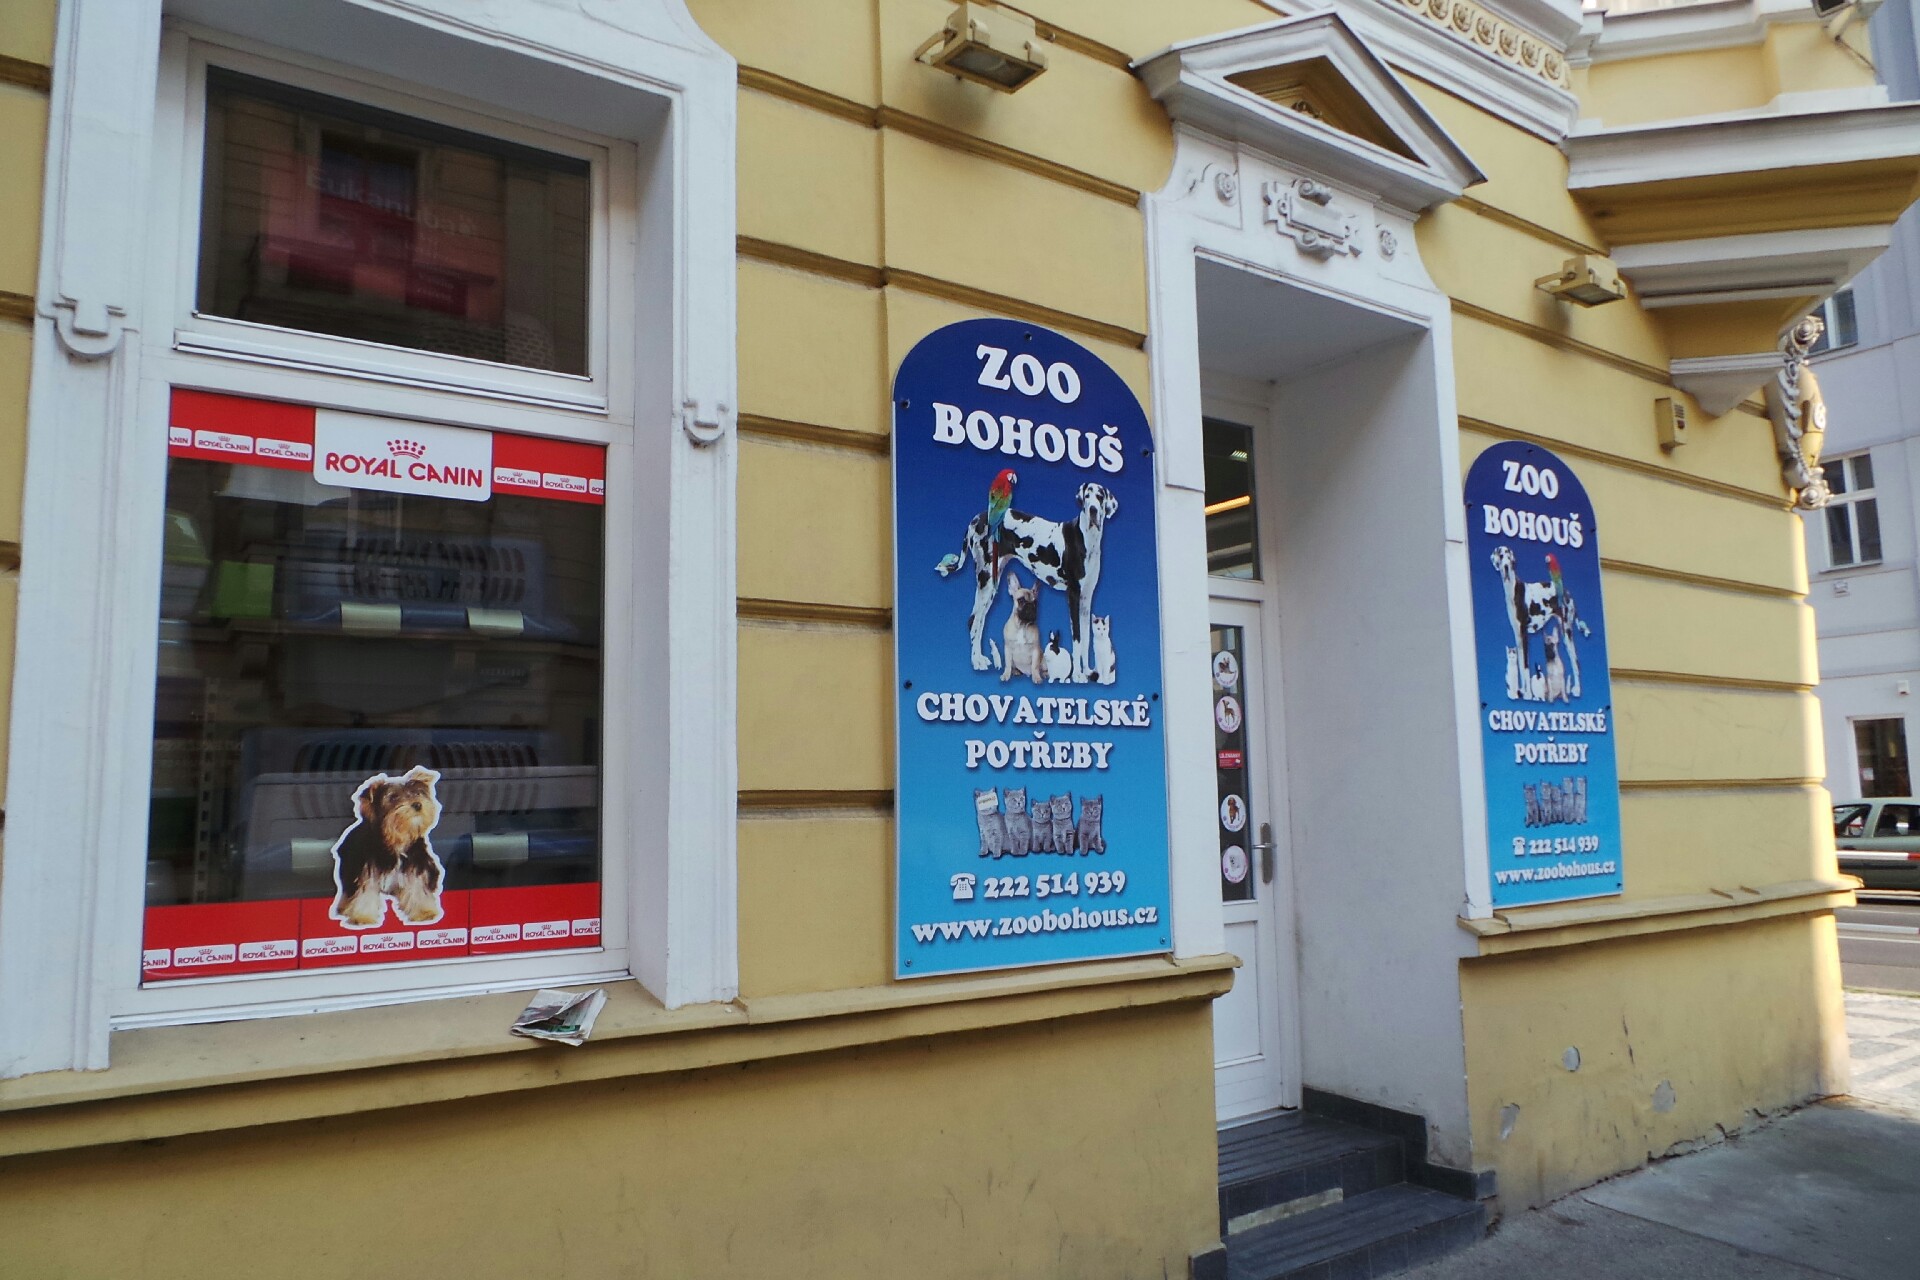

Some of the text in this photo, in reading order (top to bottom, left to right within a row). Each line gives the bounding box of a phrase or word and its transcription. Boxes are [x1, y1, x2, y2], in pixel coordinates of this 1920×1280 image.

[976, 344, 1081, 404] ZOO
[198, 440, 250, 451] ROYAL CANIN
[932, 402, 1124, 473] BOHOUŠ
[260, 448, 309, 458] ROYAL CANIN
[325, 452, 483, 488] ROYAL CANIN
[1502, 460, 1559, 499] ZOO
[1483, 504, 1583, 549] BOHOUŠ
[916, 692, 1150, 727] CHOVATELSKÉ
[1489, 708, 1607, 733] CHOVATELSKÉ
[965, 730, 1113, 768] POTŘEBY
[1515, 736, 1588, 764] POTŘEBY
[1530, 836, 1599, 854] 222 514 939
[984, 870, 1126, 899] 222 514 939
[1496, 860, 1615, 884] www.zoobohous.cz
[911, 906, 1157, 942] www.zoobohous.cz
[242, 949, 294, 959] ROYAL CANIN
[305, 945, 355, 955] ROYAL CANIN
[420, 938, 440, 946] ROYAL
